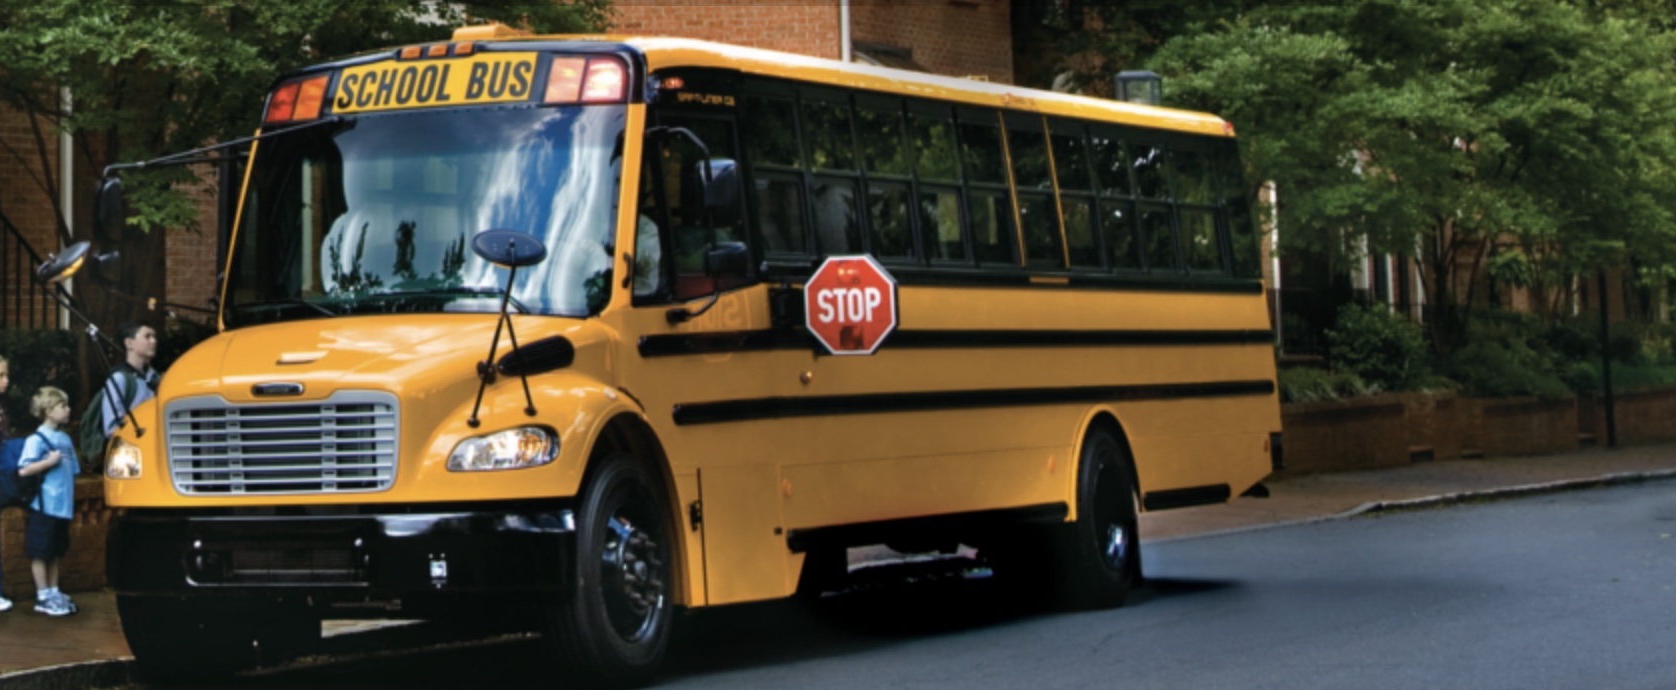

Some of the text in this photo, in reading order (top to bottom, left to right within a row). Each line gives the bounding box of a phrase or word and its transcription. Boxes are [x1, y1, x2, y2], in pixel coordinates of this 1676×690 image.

[338, 61, 531, 108] SCHOOL BUS
[817, 287, 881, 323] STOP
